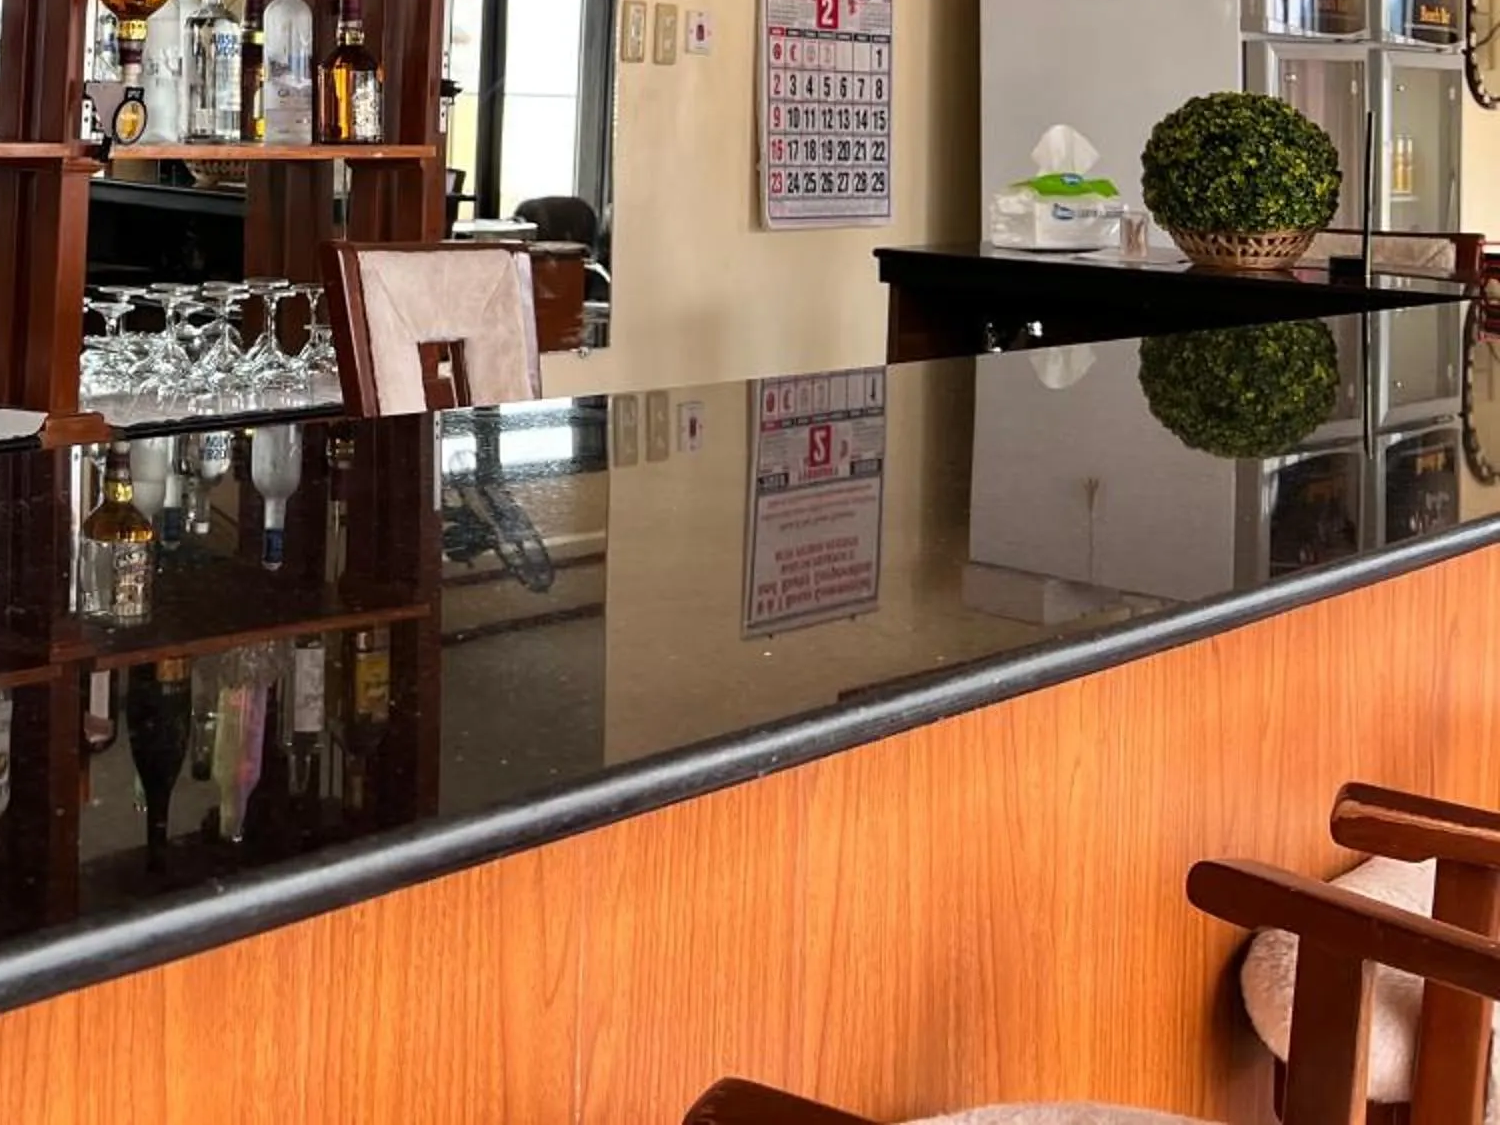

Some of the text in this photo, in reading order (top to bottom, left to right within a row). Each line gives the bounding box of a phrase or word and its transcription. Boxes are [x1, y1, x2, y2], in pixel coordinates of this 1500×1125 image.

[875, 49, 883, 68] 1
[773, 74, 883, 99] 2 3 4 5 6 7 8
[773, 107, 886, 131] 9 10 11 12 13 14 15
[787, 140, 799, 161] 17
[804, 139, 817, 161] 18
[822, 141, 833, 161] 19
[837, 141, 850, 161] 20
[855, 141, 867, 161] 21
[872, 141, 885, 162] 22
[787, 172, 800, 193] 24
[803, 172, 817, 193] 25
[838, 172, 849, 193] 27
